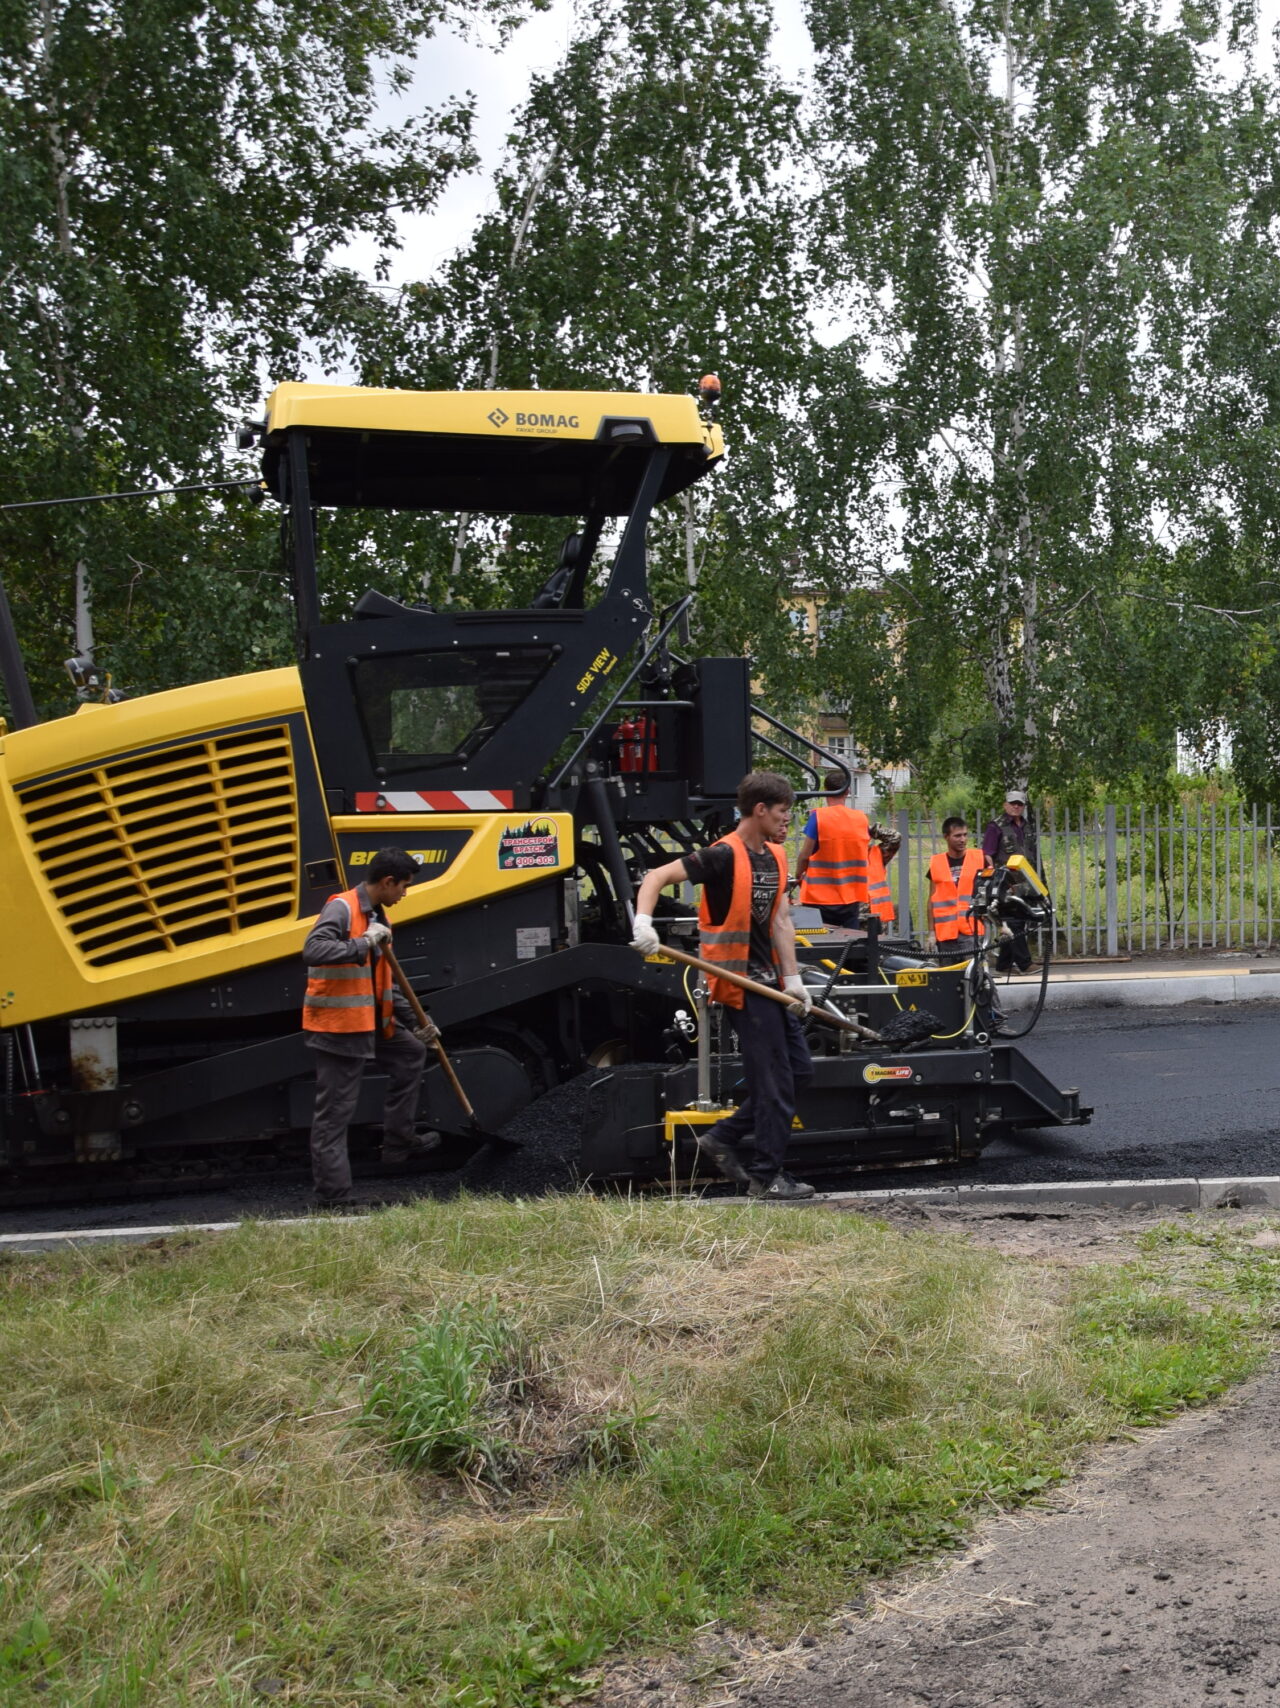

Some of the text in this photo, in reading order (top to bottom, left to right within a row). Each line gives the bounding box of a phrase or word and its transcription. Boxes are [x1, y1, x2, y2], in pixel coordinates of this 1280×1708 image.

[516, 413, 579, 428] BOMAG
[576, 647, 610, 694] SIDE VIEW
[503, 835, 554, 846] ТРАНССТРОЙ
[514, 845, 545, 854] БРАТСК
[516, 856, 555, 866] 300-303
